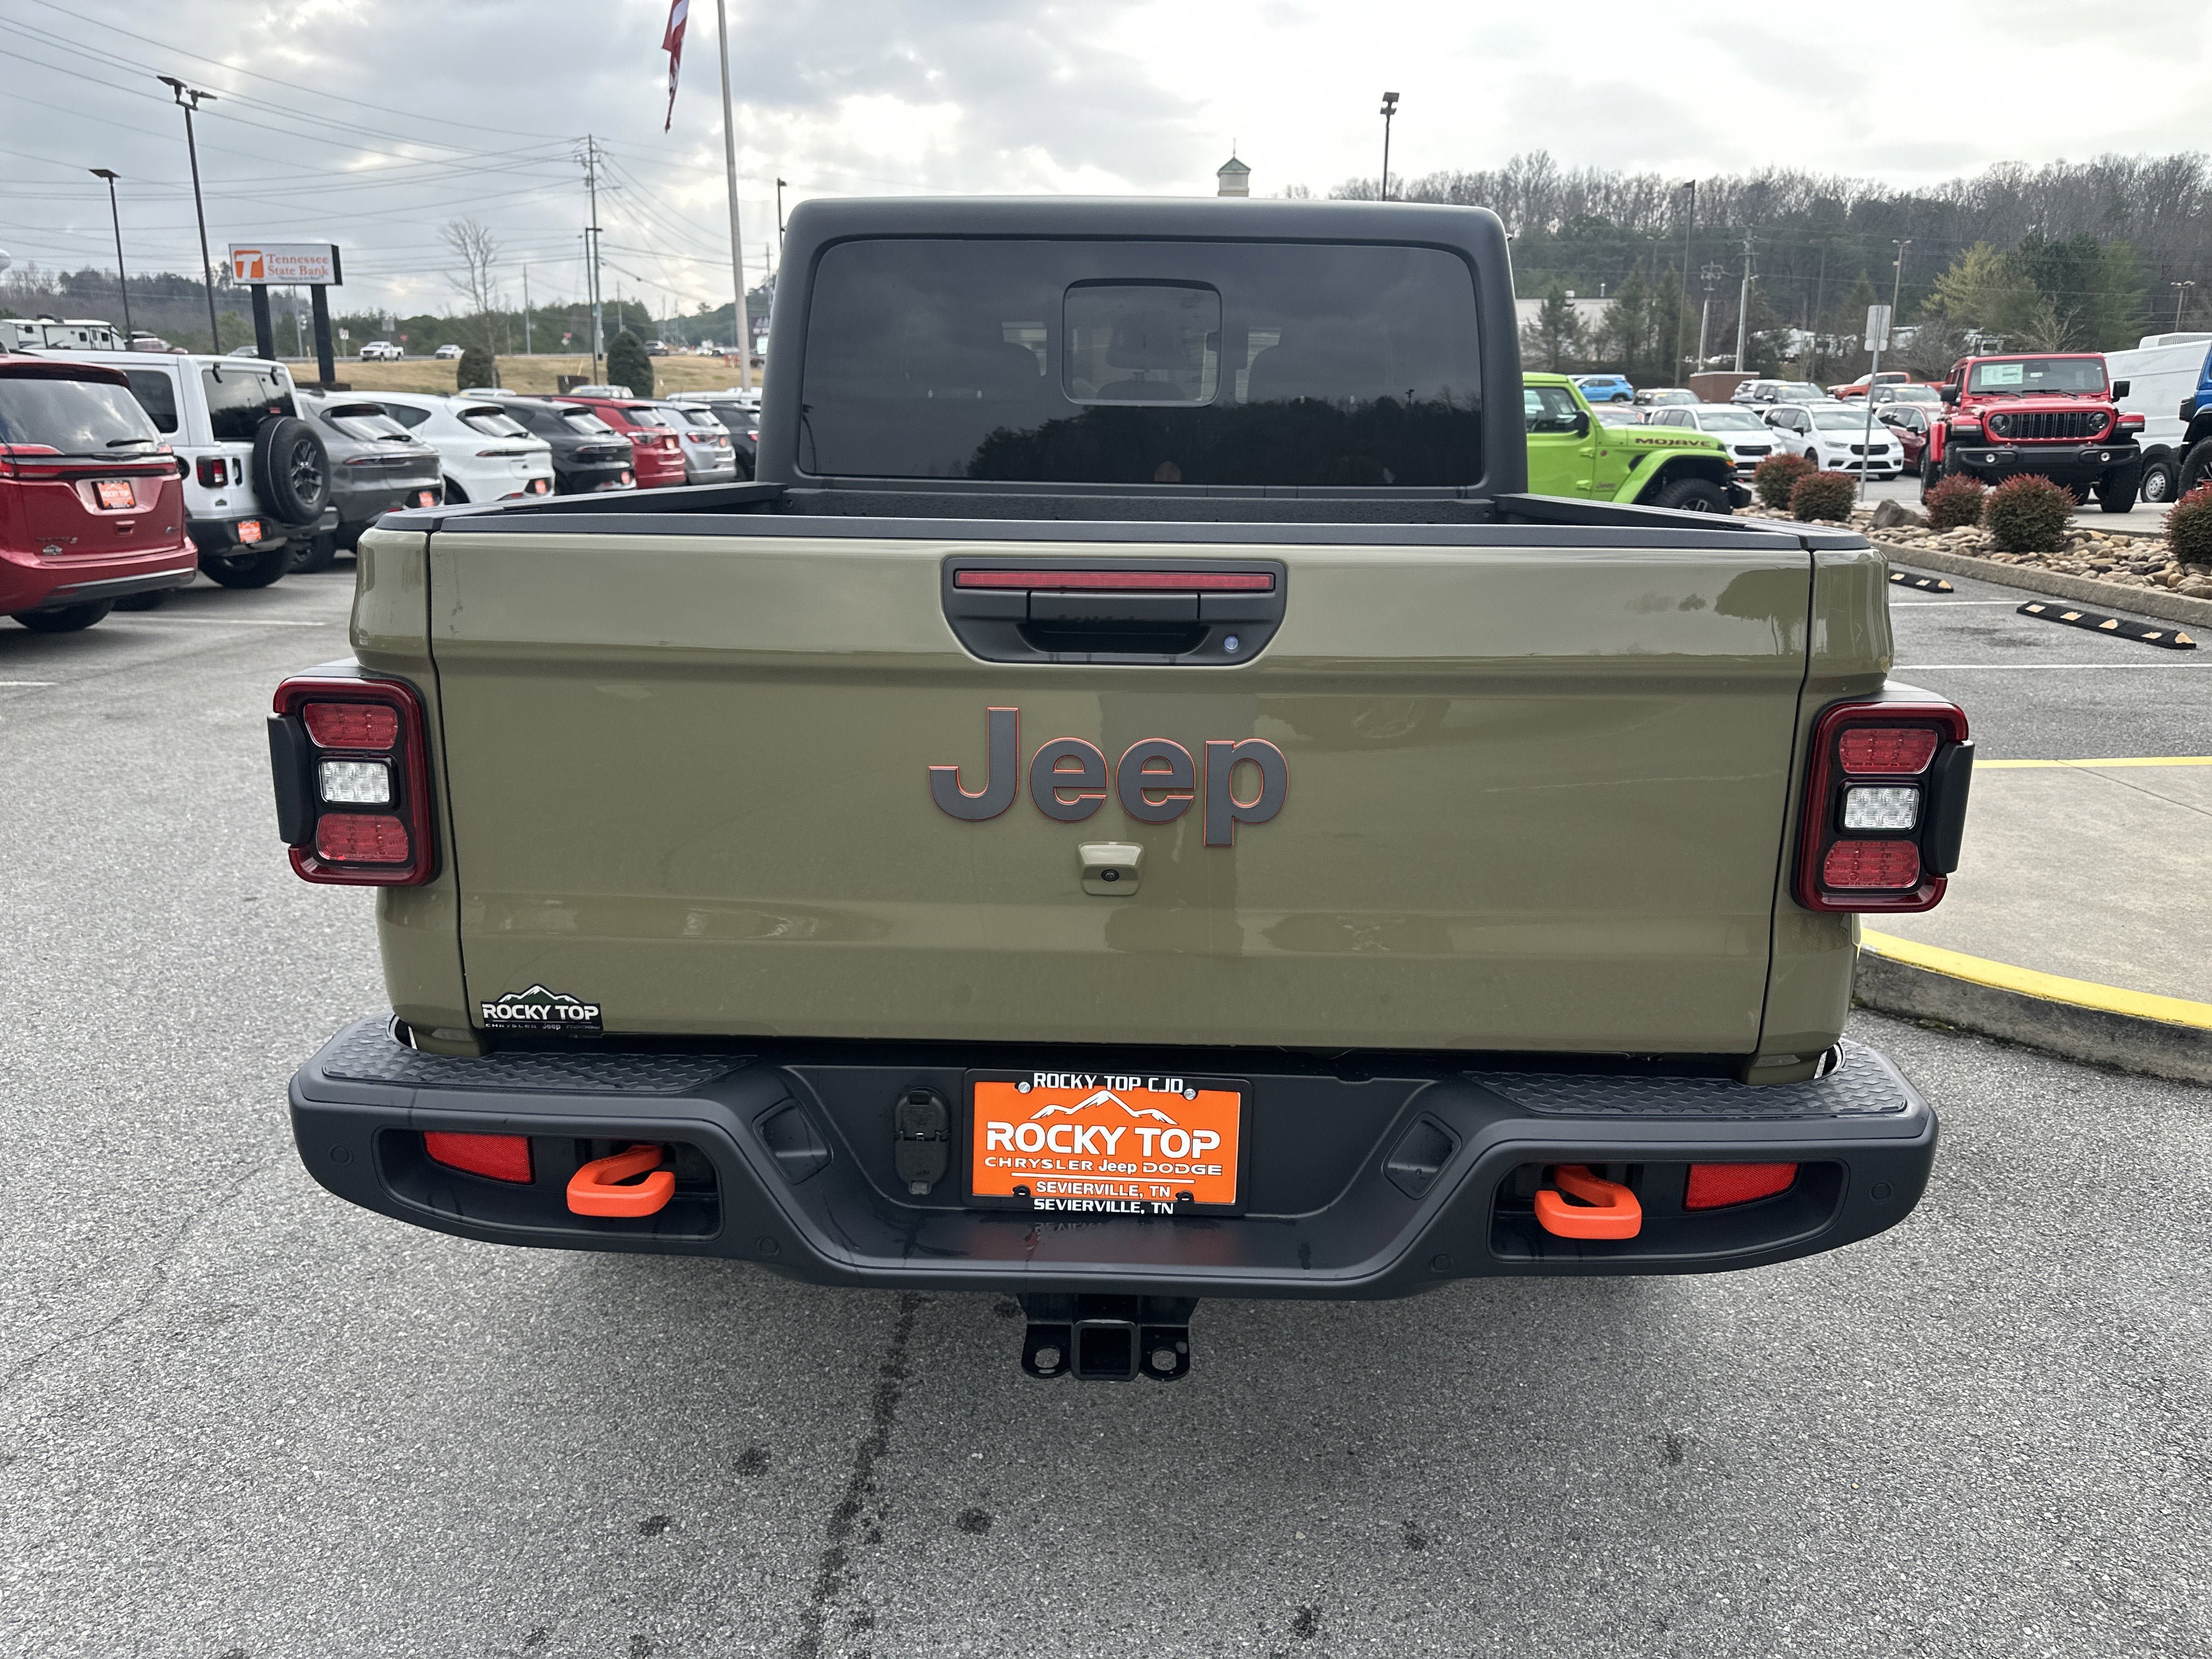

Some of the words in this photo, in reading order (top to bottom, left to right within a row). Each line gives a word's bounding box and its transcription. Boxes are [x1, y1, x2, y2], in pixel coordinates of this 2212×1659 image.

[266, 253, 328, 264] Tennessee
[267, 265, 295, 275] State
[299, 266, 328, 275] Bank
[1635, 438, 1711, 447] MOJAVE
[929, 706, 1289, 847] Jeep
[482, 1003, 551, 1020] ROCKY
[555, 1005, 599, 1020] TOP
[1034, 1073, 1097, 1090] ROCKY
[1103, 1075, 1142, 1092] TOP
[1148, 1077, 1183, 1093] CJD
[987, 1121, 1128, 1155] ROCKY
[1134, 1127, 1221, 1159] TOP
[984, 1156, 1094, 1171] CHRYSLER
[1098, 1159, 1137, 1175] Jeep
[1143, 1162, 1222, 1176] DODGE
[1036, 1181, 1143, 1199] SEVIERVILLE,
[1149, 1186, 1171, 1198] TN
[1034, 1199, 1146, 1215] SEVIERVILLE,
[1150, 1202, 1173, 1215] TN
